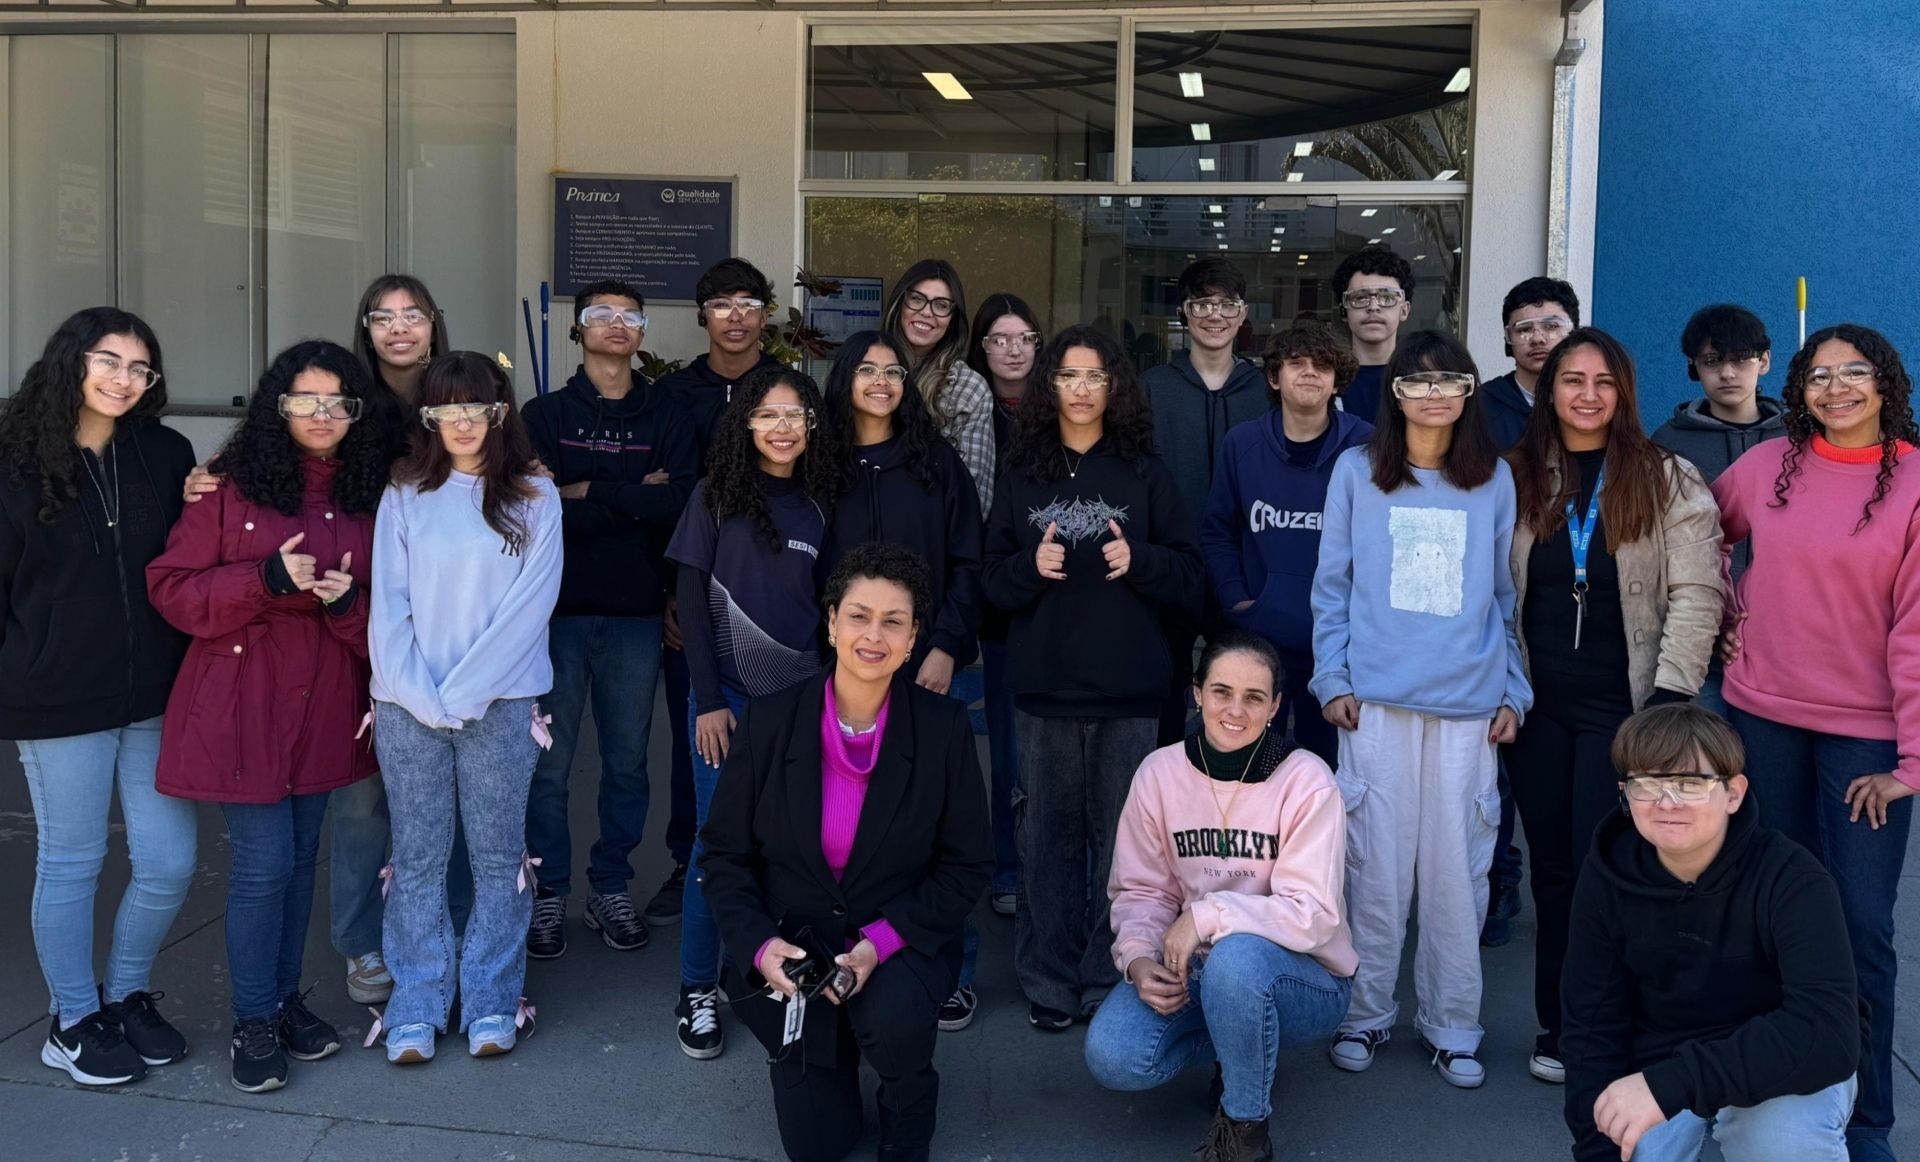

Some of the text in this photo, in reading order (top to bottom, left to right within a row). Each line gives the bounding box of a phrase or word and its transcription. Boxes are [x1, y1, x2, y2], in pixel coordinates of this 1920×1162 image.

[677, 189, 720, 198] Qualidade
[1173, 828, 1280, 860] BROOKLYN
[1203, 867, 1257, 878] NEW YORK
